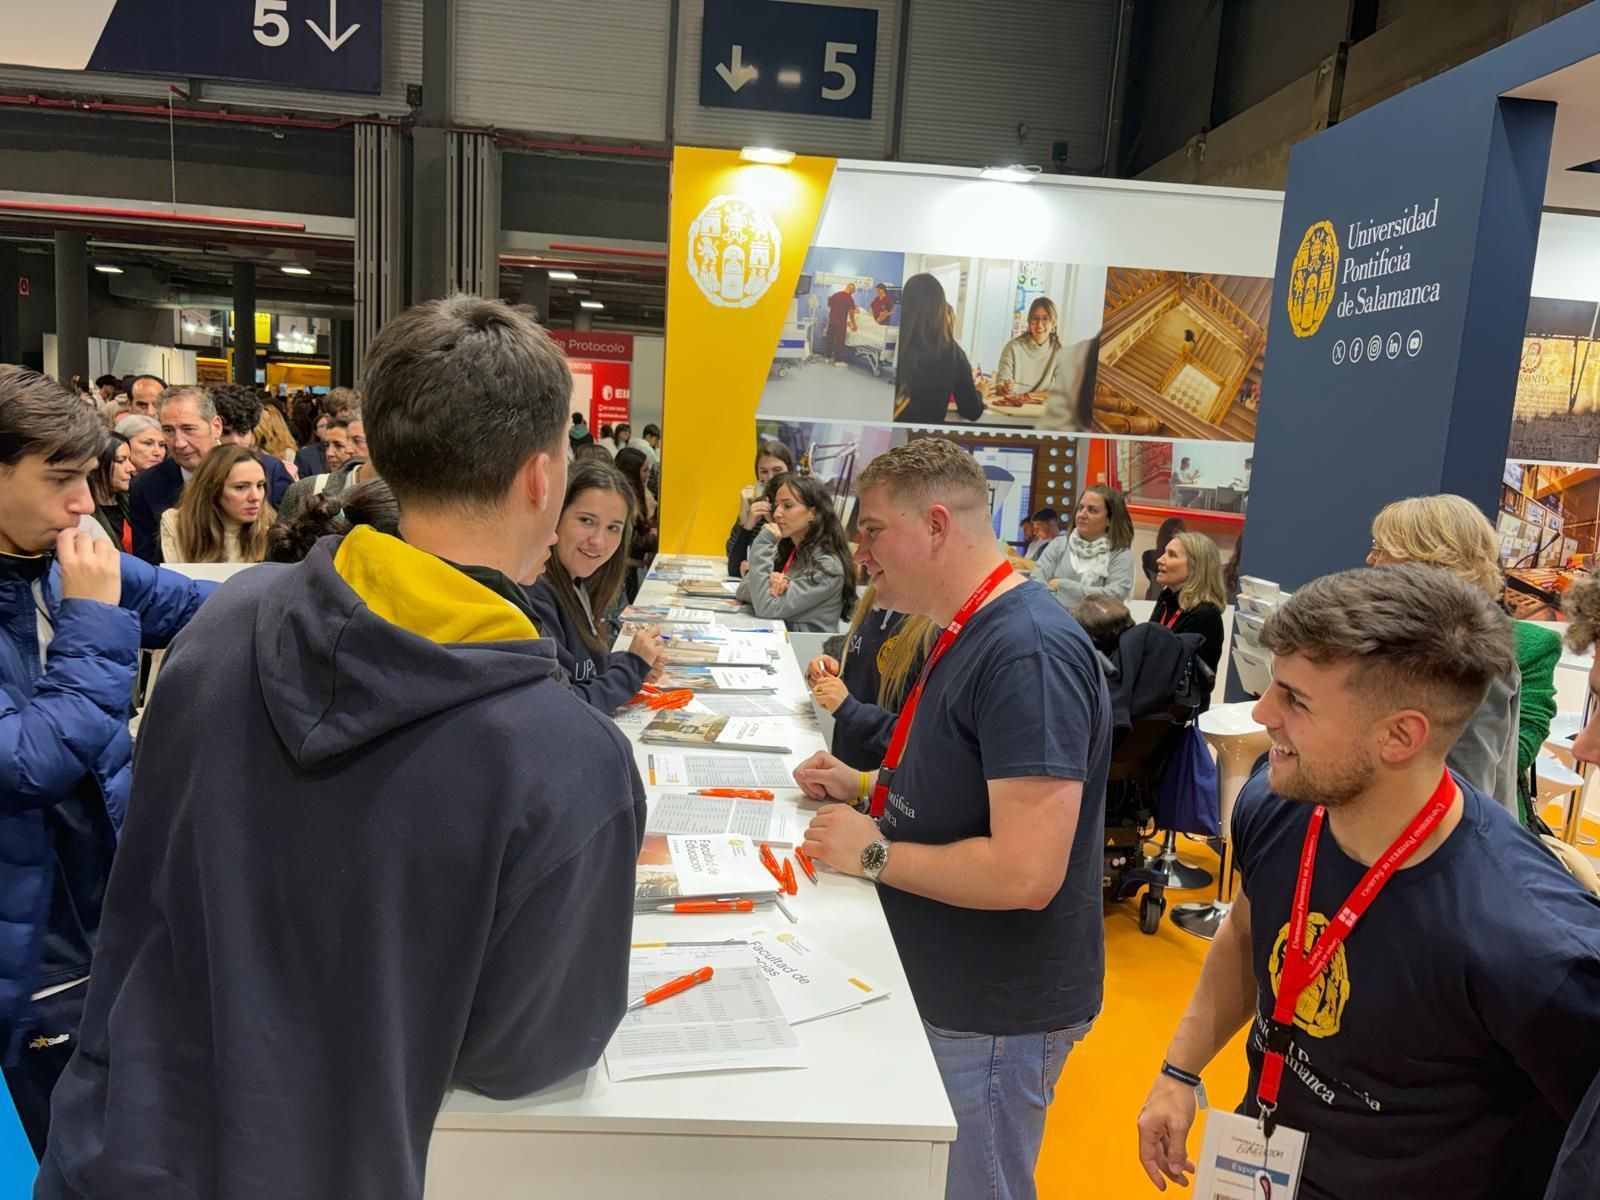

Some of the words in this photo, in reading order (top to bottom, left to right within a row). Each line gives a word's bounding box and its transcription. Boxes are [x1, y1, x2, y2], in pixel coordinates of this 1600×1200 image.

[252, 0, 290, 47] 5
[821, 41, 858, 101] 5
[1347, 198, 1440, 250] Universidad
[1341, 245, 1411, 285] Pontificia
[1336, 291, 1354, 318] de
[1354, 281, 1441, 315] Salamanca
[568, 339, 625, 353] Protocolo
[685, 839, 703, 873] Educación
[699, 839, 719, 868] Facultad
[750, 940, 798, 974] Facultad
[791, 972, 810, 985] de
